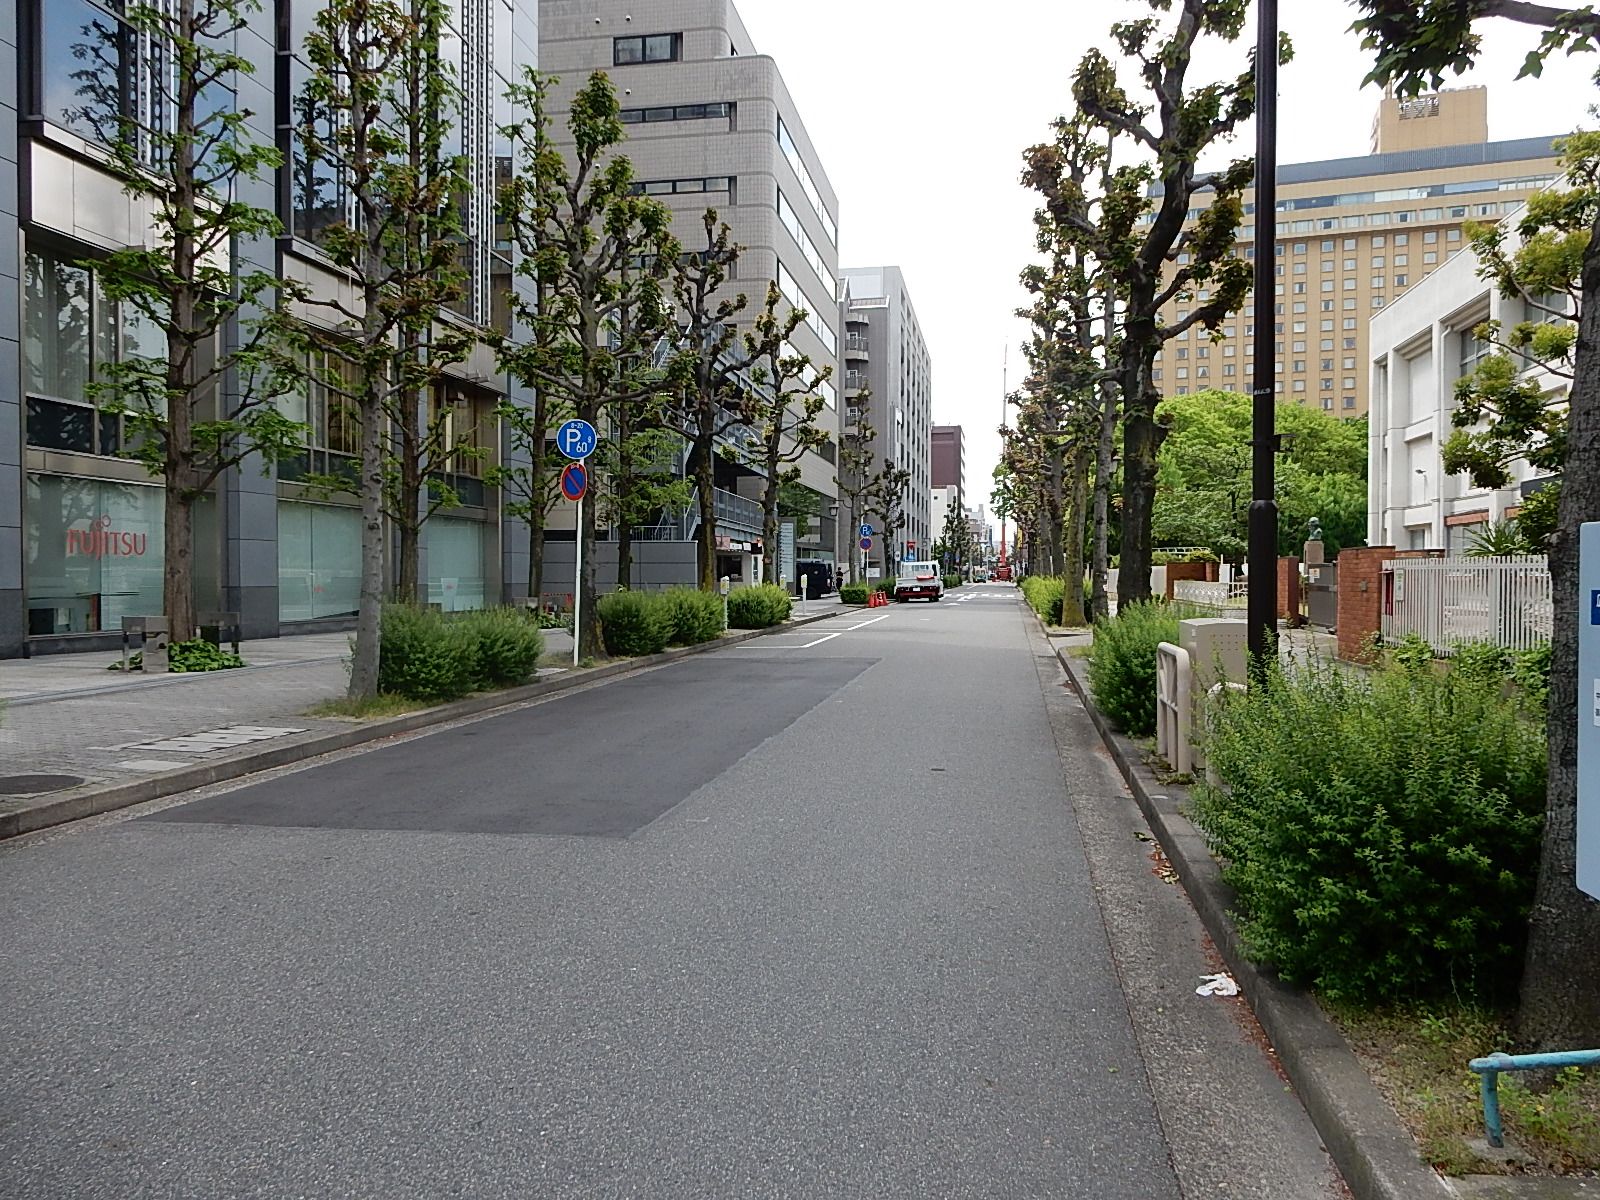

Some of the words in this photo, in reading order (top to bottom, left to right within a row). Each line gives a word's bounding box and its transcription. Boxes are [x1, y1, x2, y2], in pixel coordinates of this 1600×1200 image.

[566, 428, 582, 453] P
[576, 441, 588, 453] 60
[66, 529, 146, 560] FUJITSU
